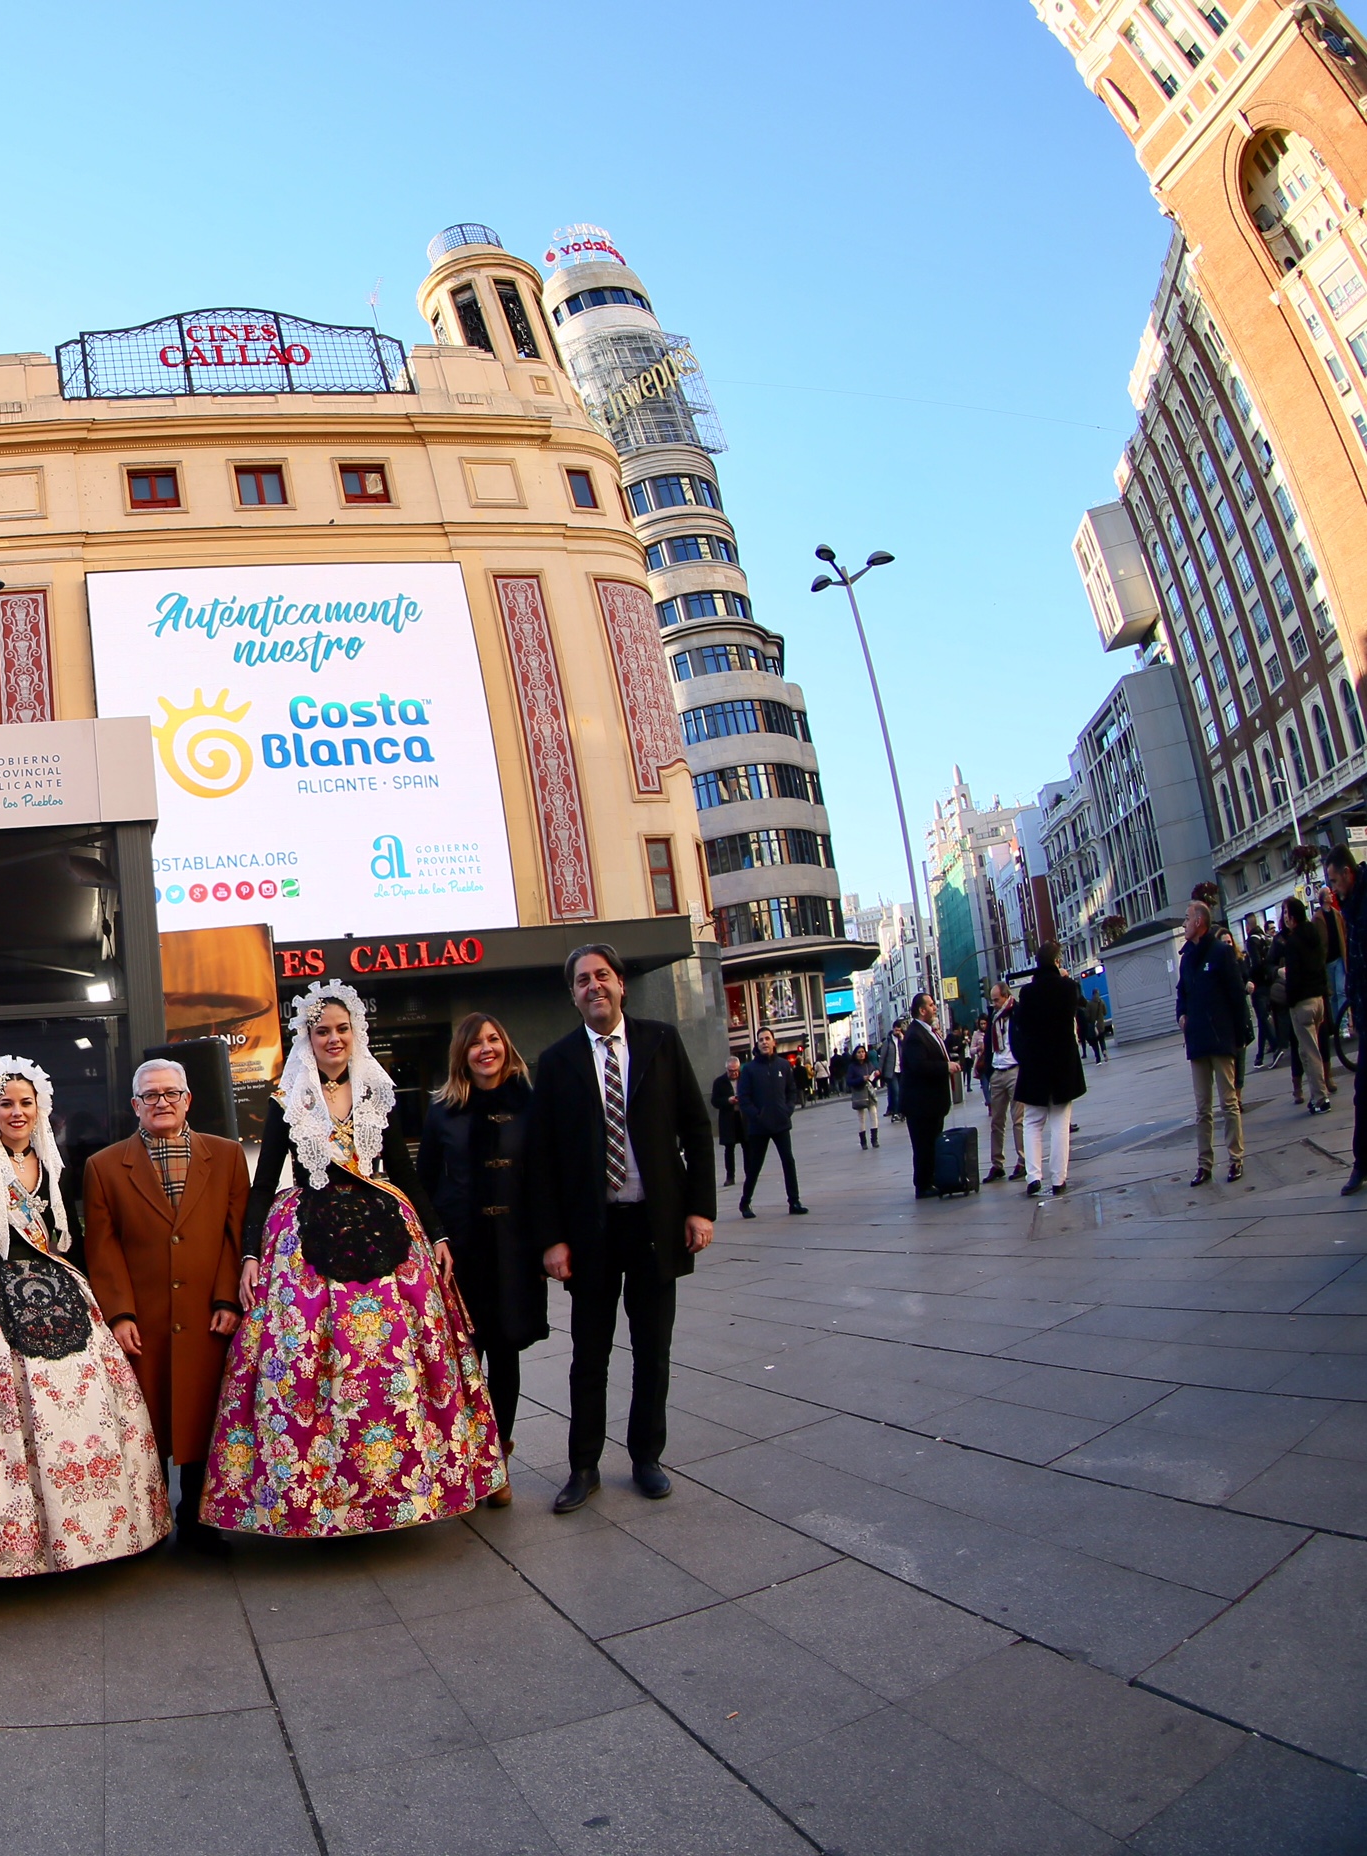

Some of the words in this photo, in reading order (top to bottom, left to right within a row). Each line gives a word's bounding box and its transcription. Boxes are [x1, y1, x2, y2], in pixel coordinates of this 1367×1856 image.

[186, 324, 278, 342] CINES
[159, 343, 311, 367] CALLAO
[585, 343, 700, 436] Schweppes
[148, 592, 423, 640] Auténticamente
[233, 630, 366, 673] nuestro
[289, 693, 430, 730] Costa
[261, 732, 435, 769] Blanca
[297, 776, 378, 794] ALICANTE
[392, 774, 440, 790] SPAIN
[3, 797, 18, 809] los
[21, 793, 63, 807] Pueblos
[416, 843, 478, 854] GOBIERNO
[417, 854, 480, 865] PROVINCIAL
[419, 866, 481, 877] ALICANTE
[374, 883, 390, 898] La
[391, 884, 416, 900] Dipu
[418, 883, 430, 895] de
[433, 882, 446, 894] los
[448, 880, 484, 892] Pueblos
[275, 948, 326, 977] ES
[349, 937, 484, 973] CALLAO
